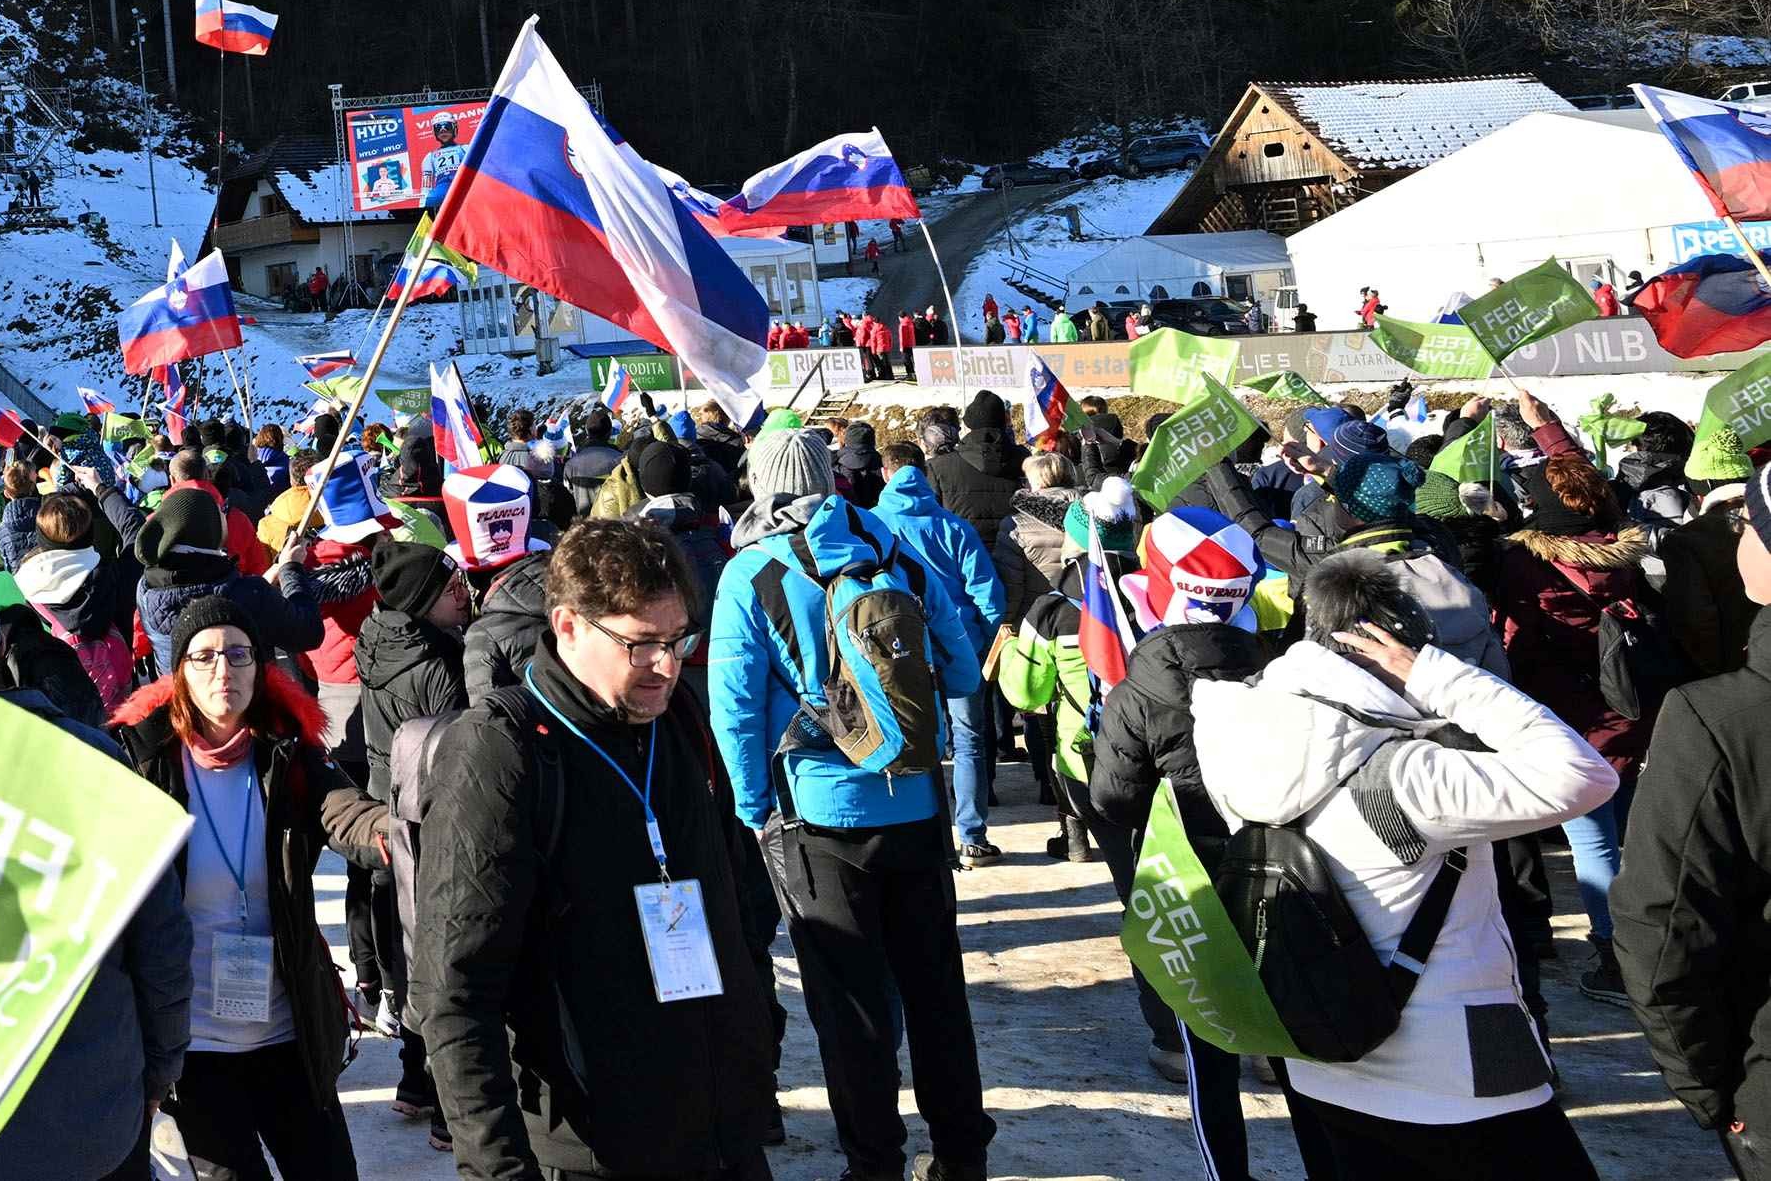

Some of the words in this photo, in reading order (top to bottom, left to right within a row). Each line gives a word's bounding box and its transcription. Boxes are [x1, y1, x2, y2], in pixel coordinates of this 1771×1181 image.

[356, 120, 398, 139] HYLO
[359, 149, 377, 158] HYLO
[383, 144, 401, 153] HYLO
[438, 154, 455, 168] 21
[1482, 296, 1529, 330] FEEL
[1575, 330, 1645, 364] NLB
[793, 352, 857, 371] RIHTER
[961, 349, 1014, 375] Sintal
[1339, 353, 1402, 367] ZLATARN
[477, 506, 525, 523] PLANICA
[1142, 851, 1208, 962] FEEL
